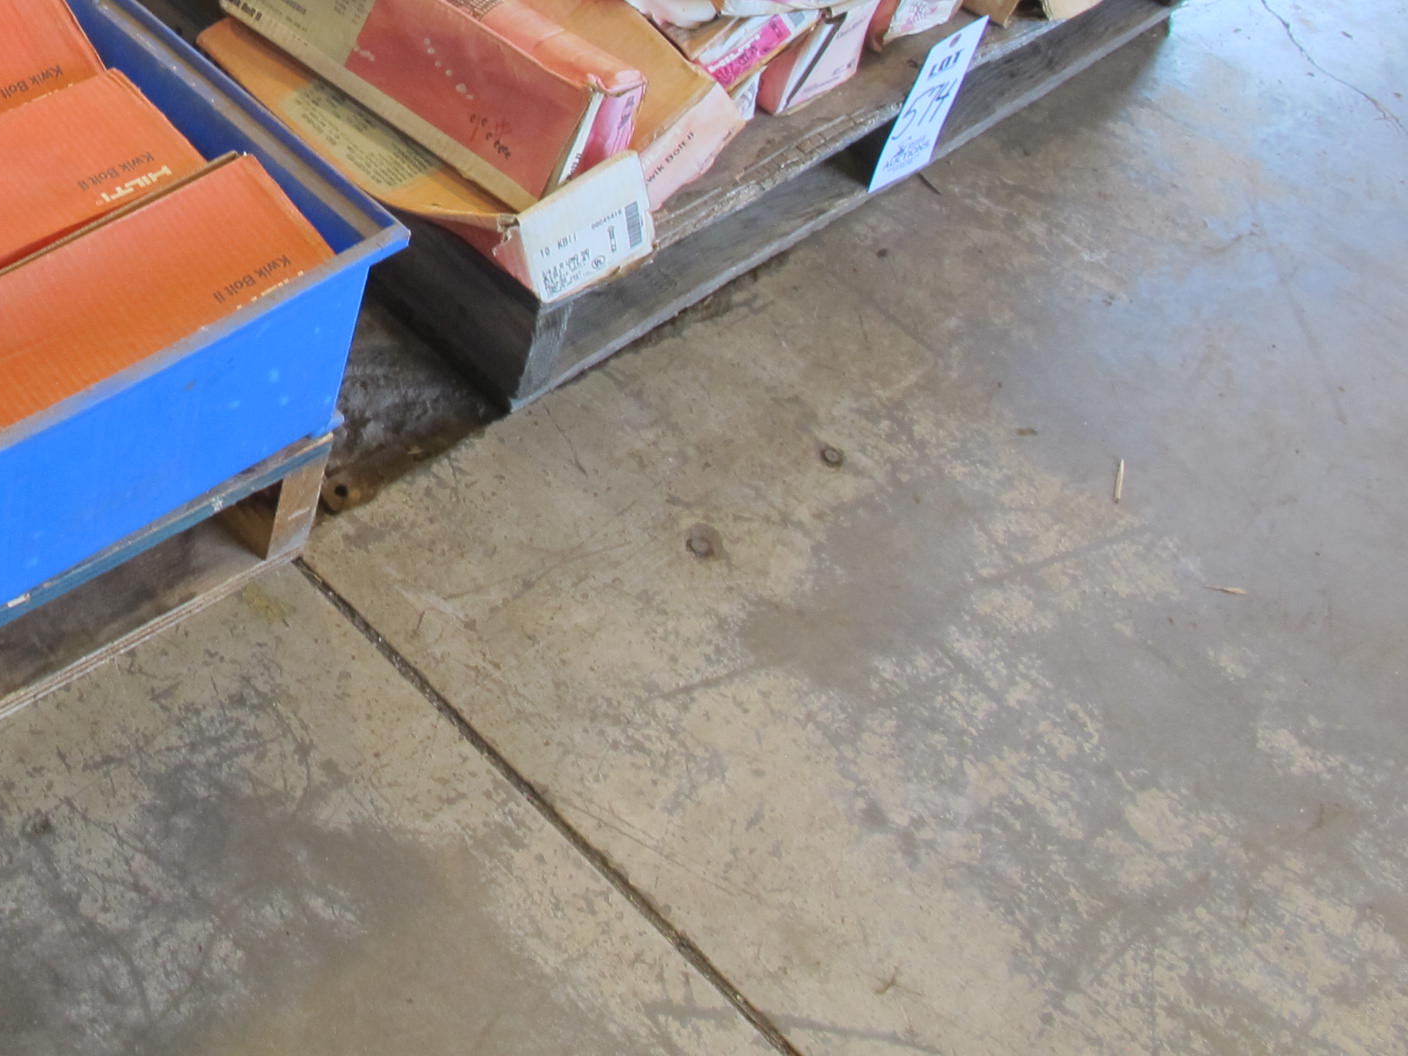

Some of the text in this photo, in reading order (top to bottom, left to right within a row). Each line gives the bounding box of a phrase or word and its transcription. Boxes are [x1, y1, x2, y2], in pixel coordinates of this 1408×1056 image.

[29, 64, 64, 85] Kwik
[1, 77, 30, 98] Bolt
[119, 151, 155, 172] Kwik
[91, 166, 121, 187] Bolt
[100, 164, 173, 203] HILTI
[254, 254, 291, 279] Kwik
[224, 274, 257, 297] Bolt
